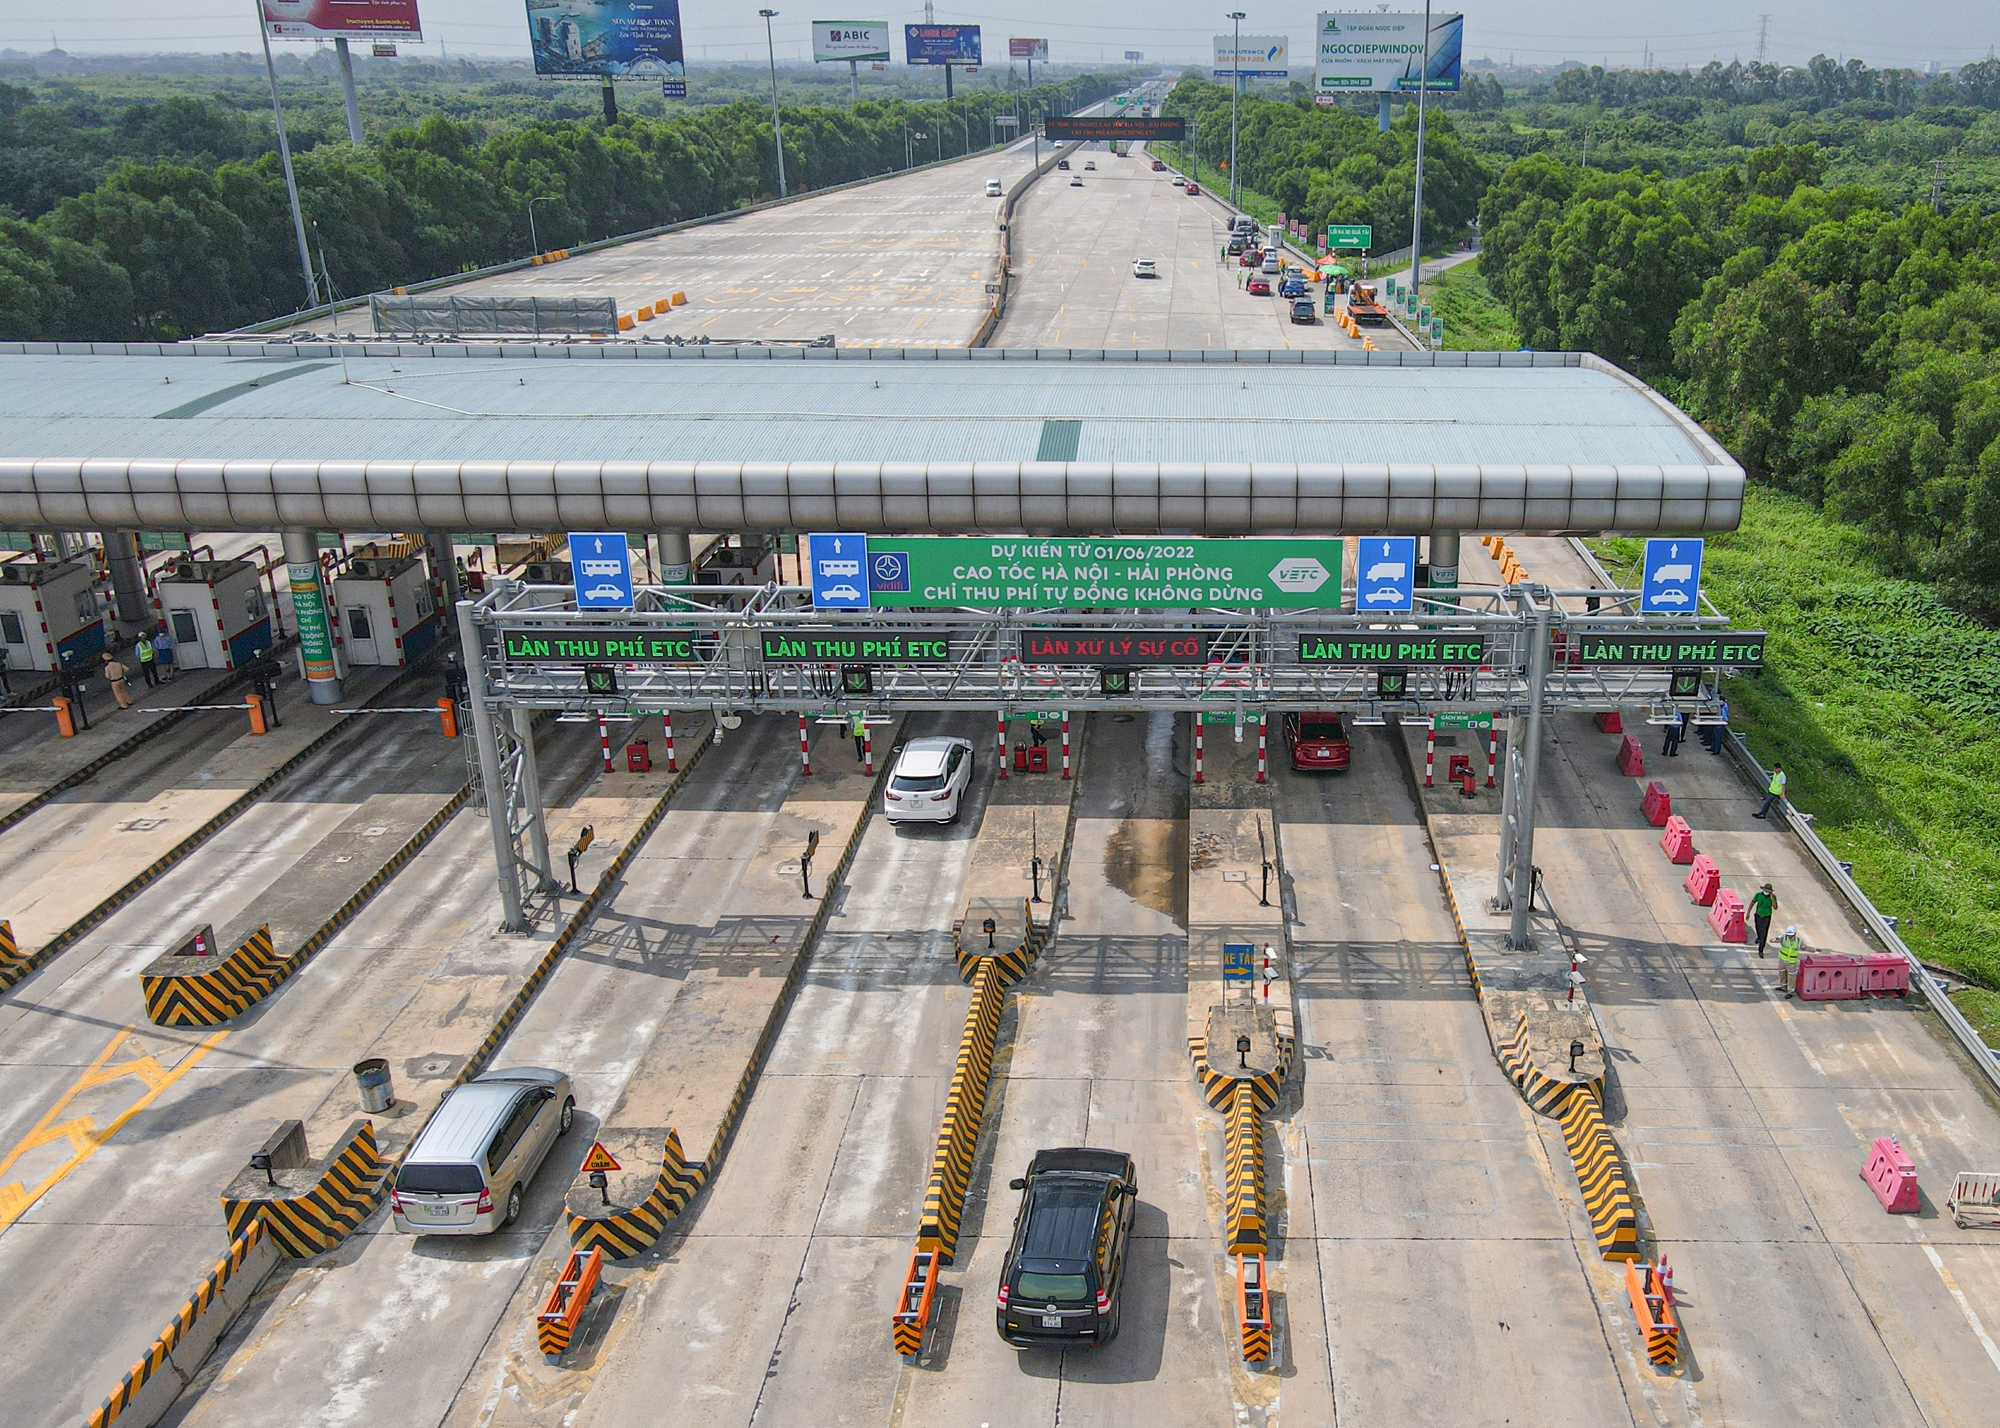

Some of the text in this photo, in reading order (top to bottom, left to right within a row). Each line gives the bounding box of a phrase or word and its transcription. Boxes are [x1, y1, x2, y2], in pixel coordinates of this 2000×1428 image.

[843, 31, 870, 40] ABIC
[991, 540, 1194, 560] DỰ KIẾN TỪ 01/06/2022
[953, 566, 992, 579] CAO
[998, 561, 1035, 580] TỐC
[1042, 563, 1069, 580] HÀ
[1075, 563, 1108, 583] NỘI
[1127, 563, 1159, 581] HẢI
[1166, 563, 1233, 581] PHÒNG
[1279, 569, 1320, 580] VETC
[923, 581, 1263, 604] CHỈ THU PHÍ TỰ ĐỘNG KHÔNG DỪNG
[507, 635, 691, 657] LÀN THU PHÍ ETC
[765, 635, 947, 657] LÀN THU PHÍ ETC
[1031, 636, 1069, 655] LÀN
[1075, 637, 1105, 655] XỬ
[1109, 636, 1133, 655] LÝ
[1138, 639, 1166, 659] SỰ
[1302, 638, 1481, 660] LÀN THU PHÍ ETC
[1583, 640, 1761, 660] LÀN THU PHÍ ETC
